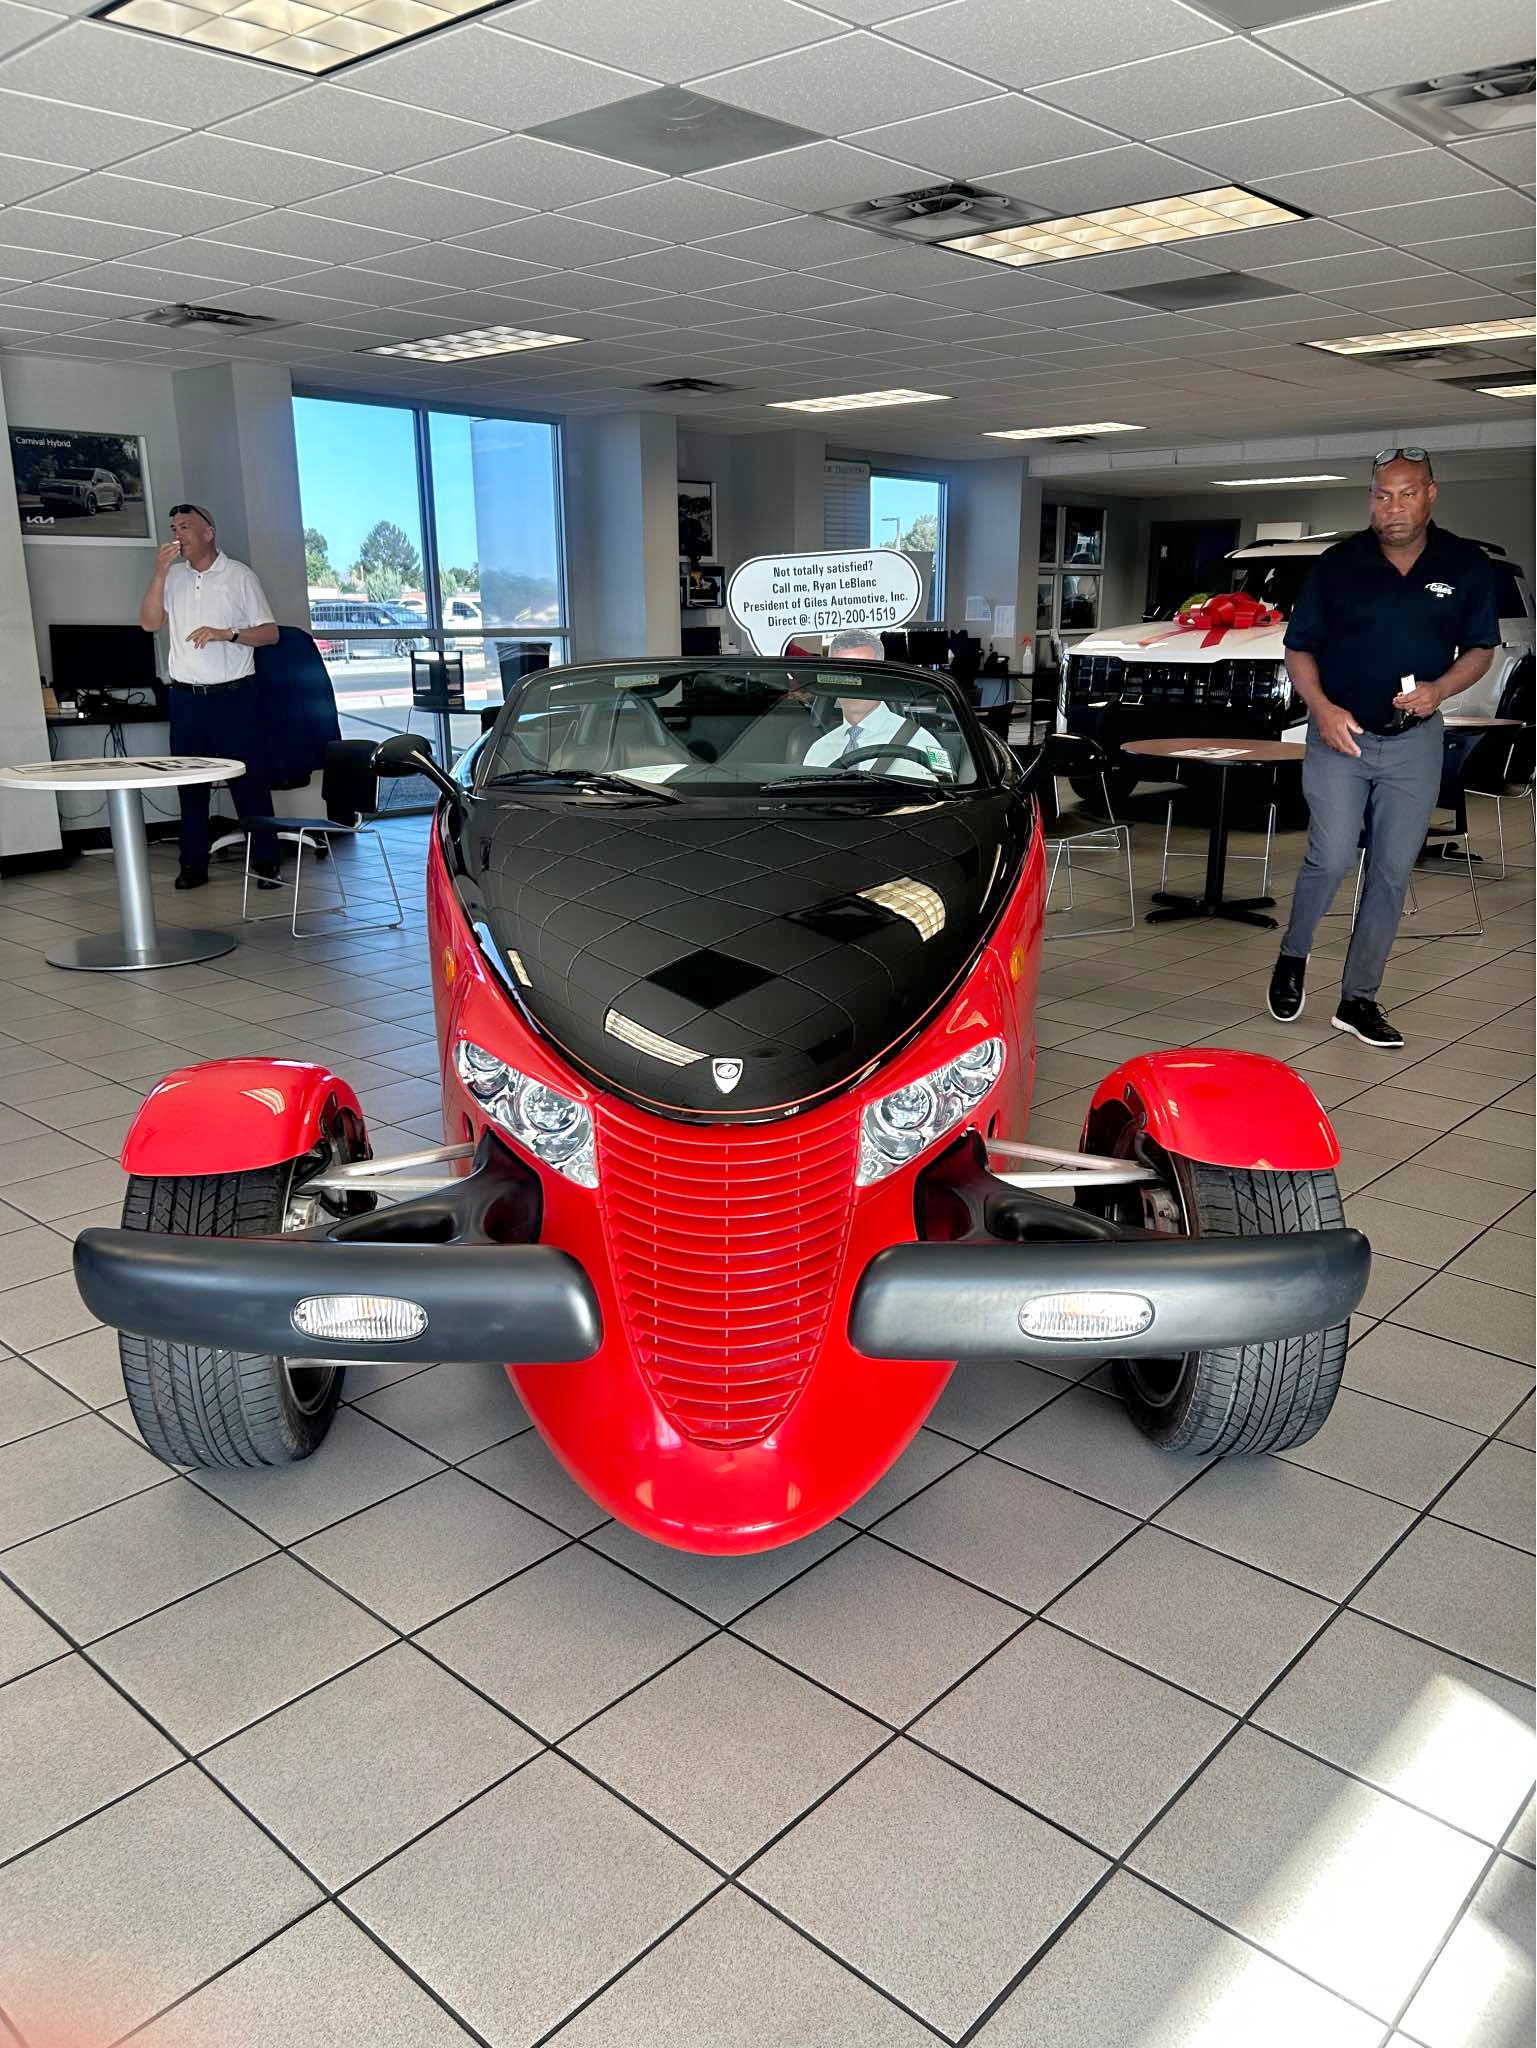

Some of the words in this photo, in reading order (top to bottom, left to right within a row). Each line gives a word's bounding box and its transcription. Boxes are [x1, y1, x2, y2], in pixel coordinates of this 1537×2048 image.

[15, 436, 46, 446] Carnival
[46, 439, 72, 448] Hybrid
[773, 566, 791, 578] Not
[793, 563, 824, 577] totally
[826, 560, 873, 574] satisfied?
[772, 582, 791, 594] Call
[793, 584, 810, 593] me,
[813, 581, 837, 594] Ryan
[839, 578, 877, 590] LeBlanc
[743, 598, 789, 613] President
[791, 598, 801, 609] of
[804, 596, 828, 608] Giles
[830, 594, 888, 607] Automotive,
[890, 591, 908, 602] Inc.
[768, 616, 797, 628] Direct
[799, 615, 811, 626] @:
[814, 606, 896, 629] (572)-200-1519
